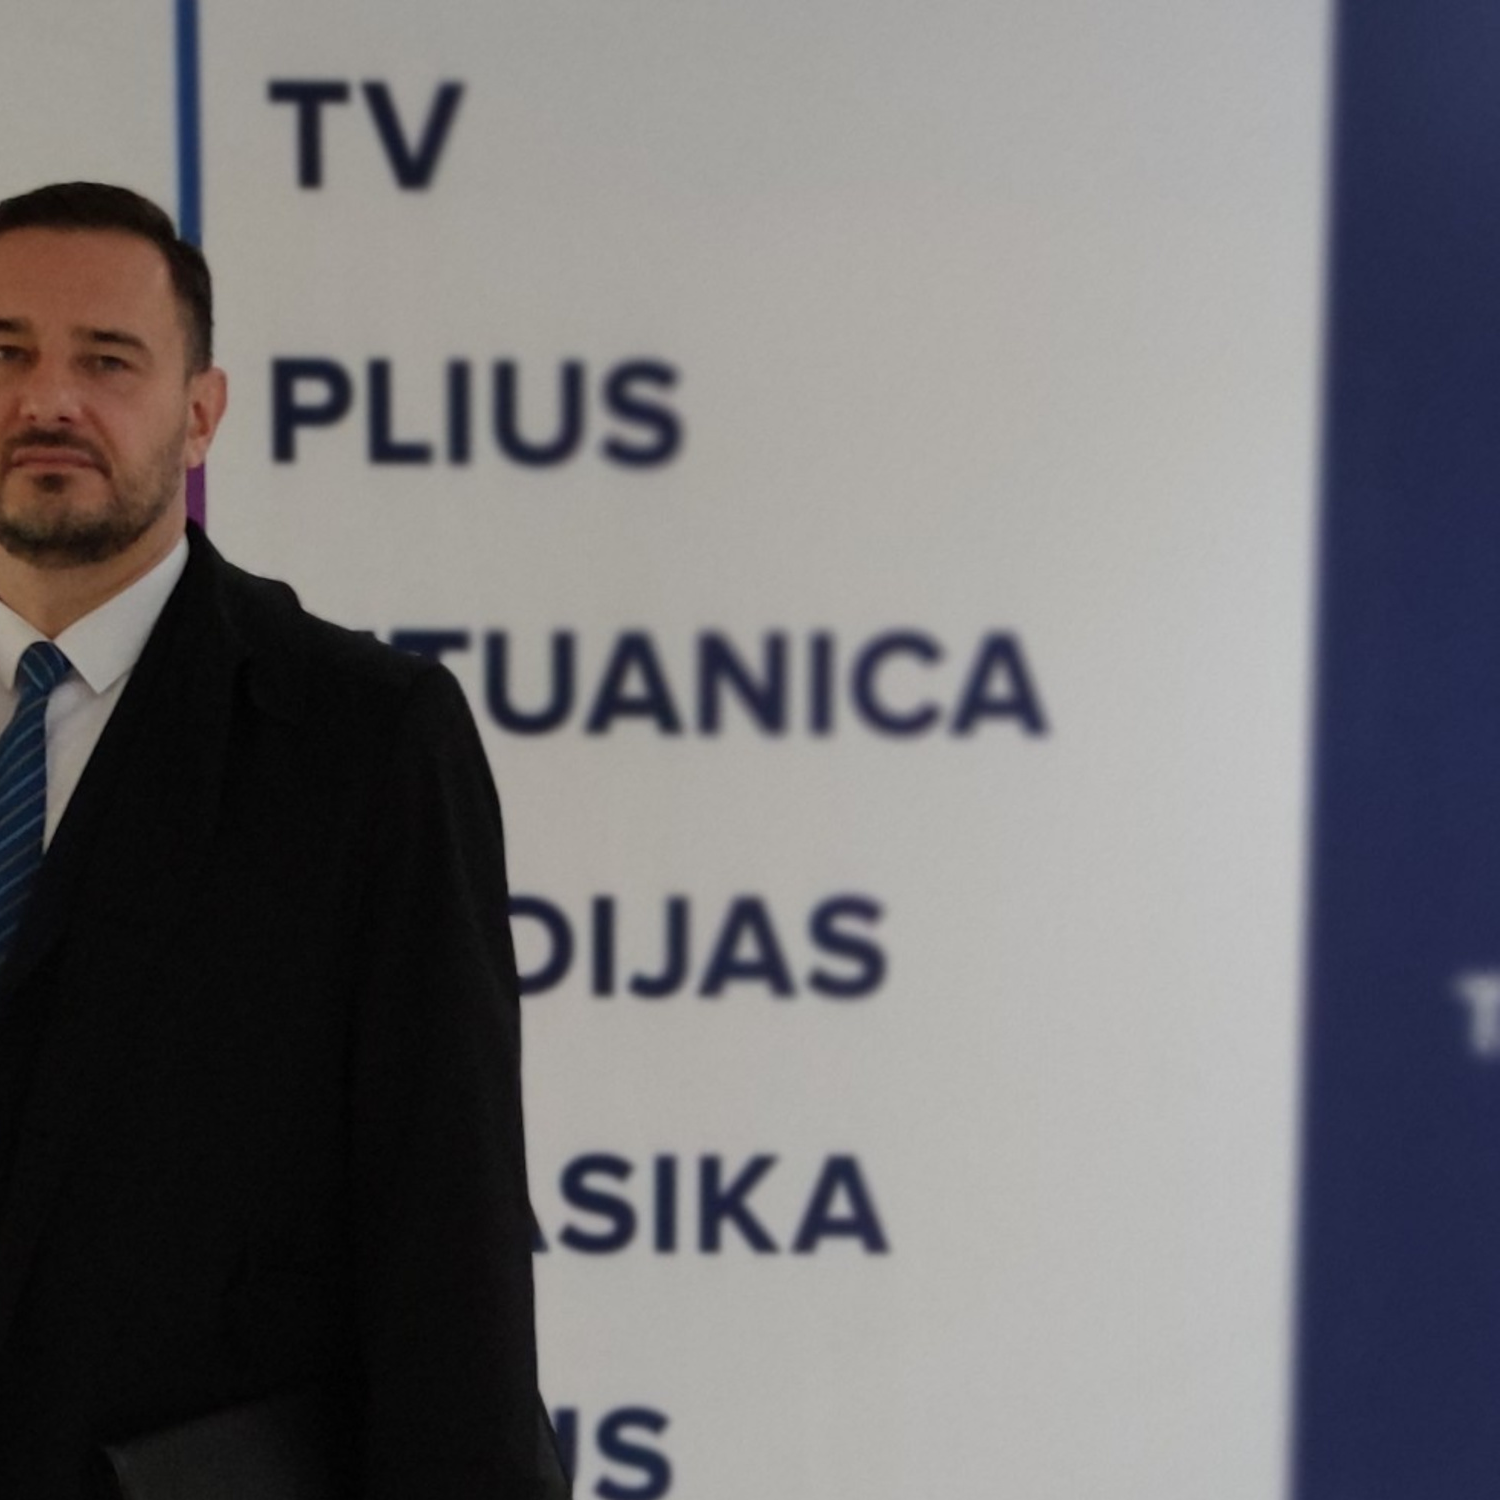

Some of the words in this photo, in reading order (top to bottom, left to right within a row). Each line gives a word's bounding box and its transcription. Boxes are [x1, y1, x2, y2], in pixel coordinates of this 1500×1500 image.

[267, 79, 465, 192] TV
[271, 357, 683, 469] PLIUS
[350, 629, 1046, 737] TUANICA
[531, 1153, 888, 1255] SIKA
